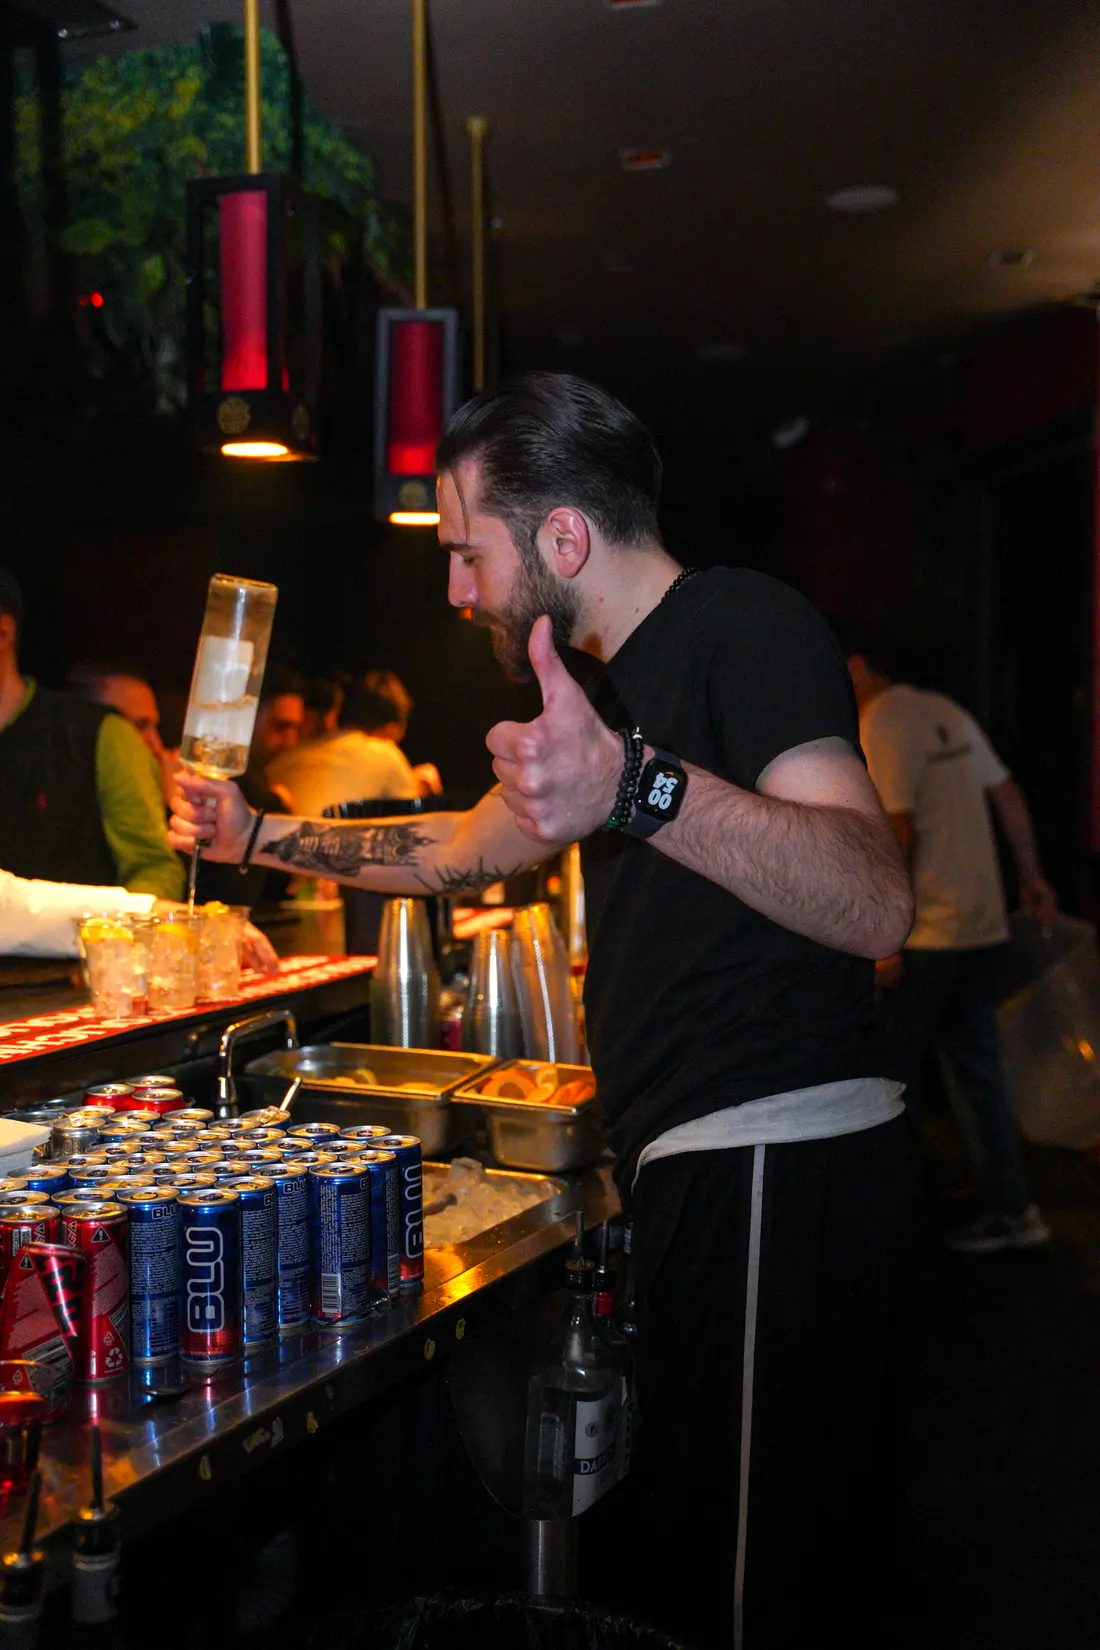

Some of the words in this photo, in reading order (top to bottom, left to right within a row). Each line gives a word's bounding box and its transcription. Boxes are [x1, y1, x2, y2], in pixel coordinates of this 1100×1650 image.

[653, 772, 678, 794] 54
[648, 789, 672, 810] 00
[185, 1226, 225, 1333] BLU
